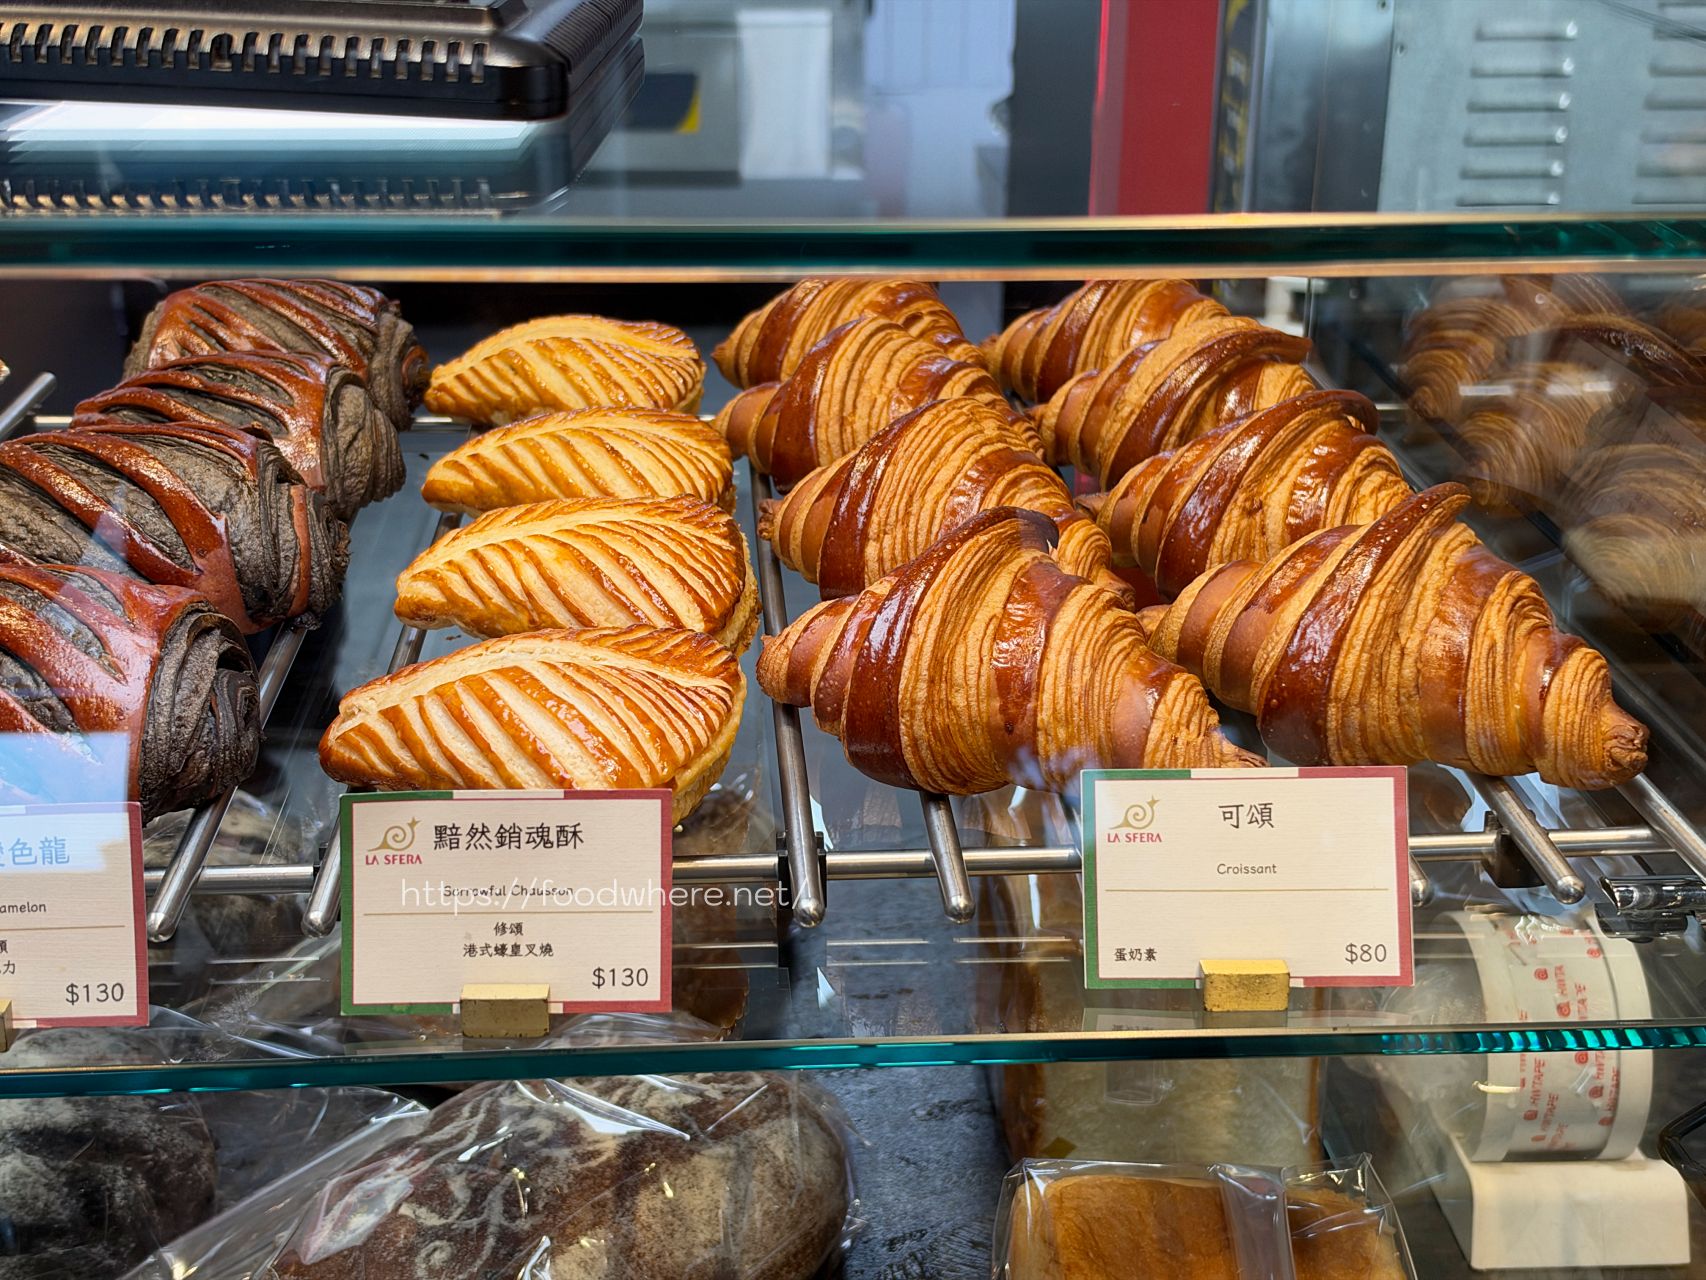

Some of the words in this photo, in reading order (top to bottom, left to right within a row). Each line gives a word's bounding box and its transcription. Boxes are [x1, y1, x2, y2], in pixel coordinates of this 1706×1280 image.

[1218, 802, 1274, 829] 可頌
[433, 822, 584, 851] 黯然銷魂酥
[1107, 833, 1120, 843] LA
[1125, 832, 1162, 843] SFERA
[0, 836, 70, 866] 色龍
[365, 855, 379, 865] LA
[384, 854, 422, 865] SFERA
[1216, 863, 1277, 875] Croissant
[493, 922, 524, 936] 修頌
[1113, 947, 1157, 961] 蛋奶素
[1345, 943, 1387, 964] $80
[591, 966, 649, 989] $130
[65, 983, 124, 1005] $130
